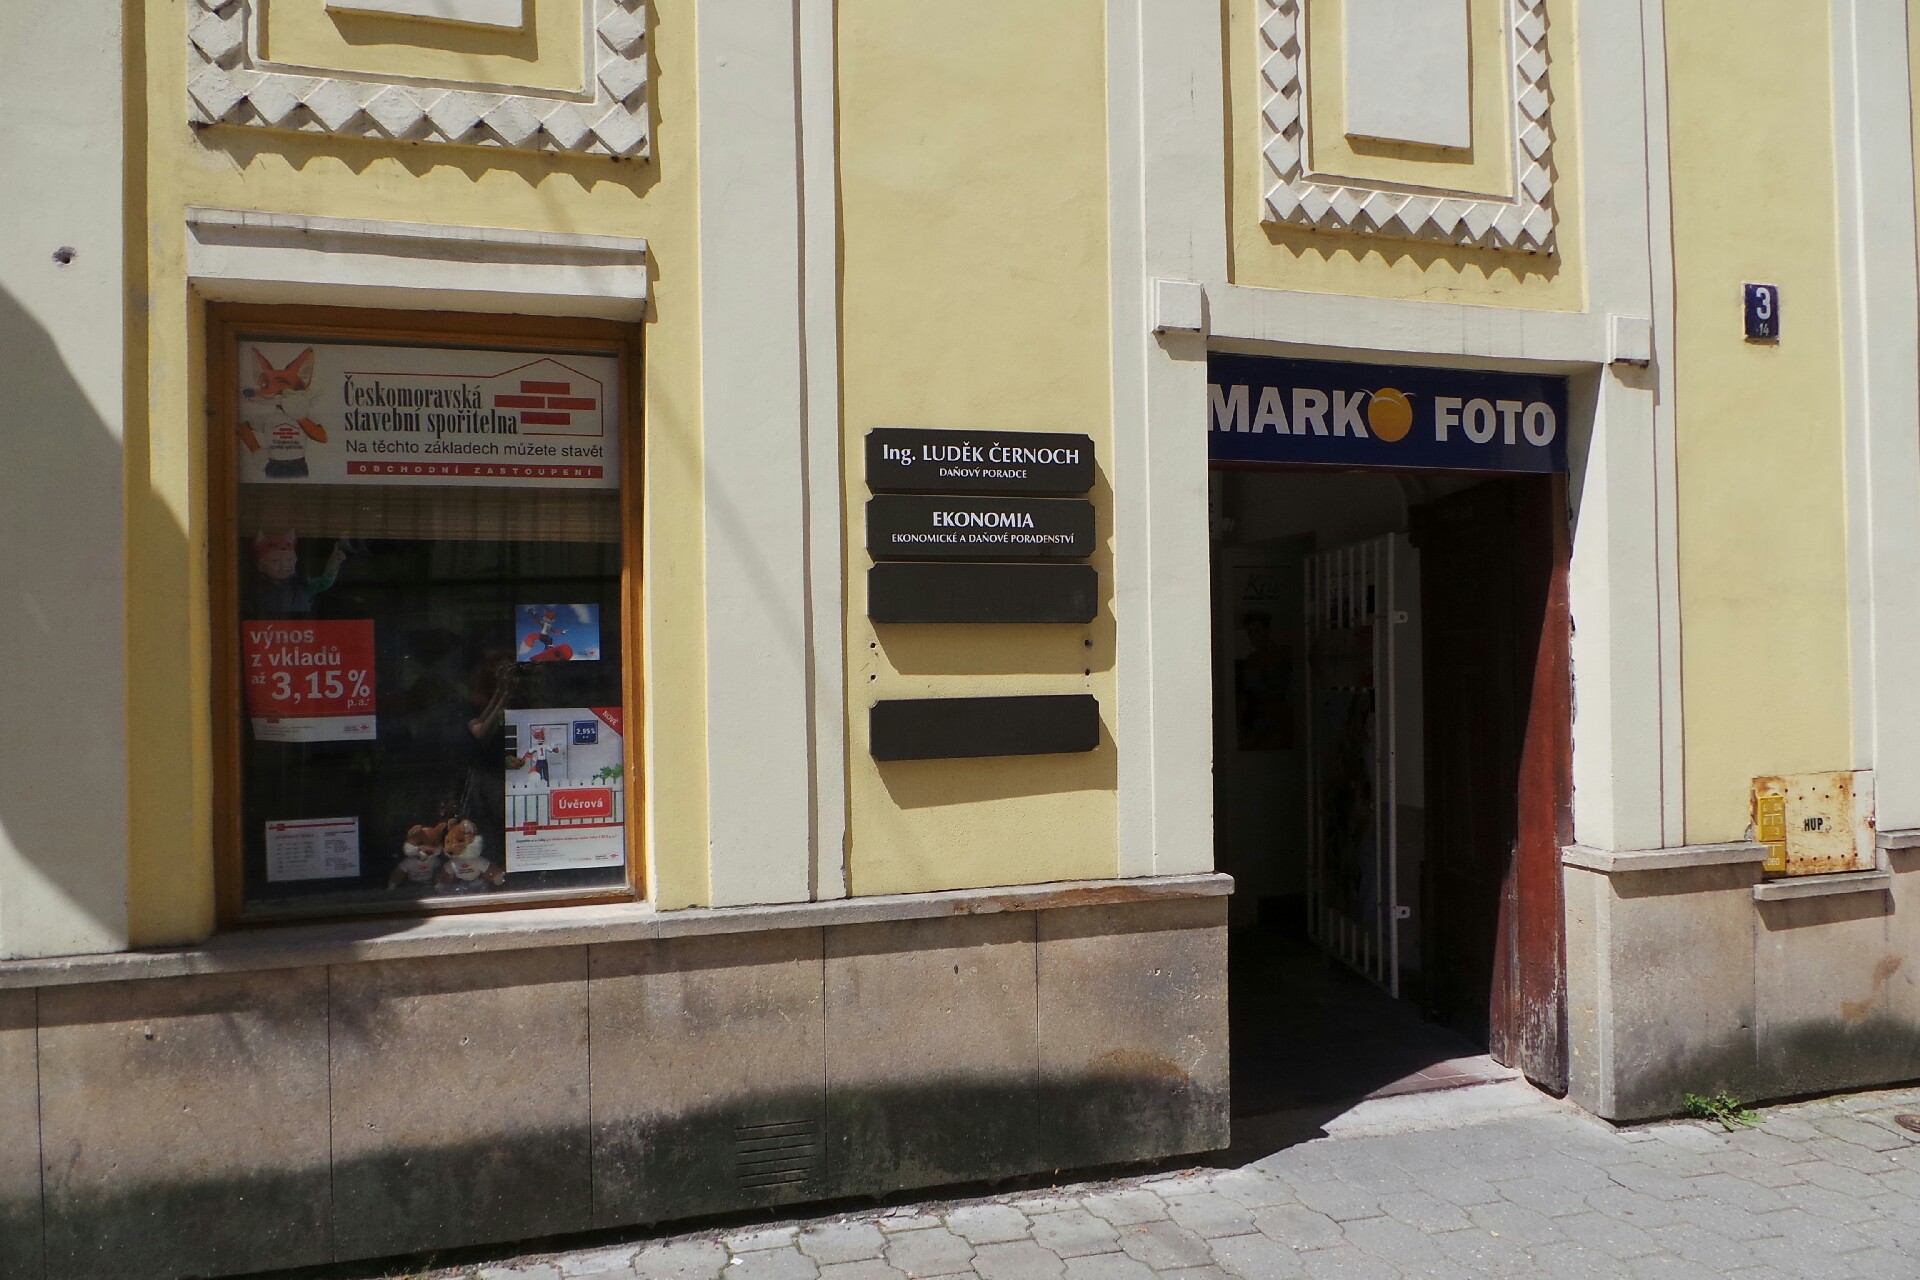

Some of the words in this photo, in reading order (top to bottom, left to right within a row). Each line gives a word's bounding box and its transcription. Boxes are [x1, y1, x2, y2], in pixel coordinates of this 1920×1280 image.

[1756, 287, 1770, 320] 3
[344, 375, 482, 410] Českomoravská
[344, 407, 421, 432] stavební
[427, 409, 518, 439] spořitelna
[1434, 396, 1556, 447] FOTO
[346, 440, 367, 453] Na
[373, 440, 419, 454] těchto
[425, 441, 498, 455] základech
[504, 443, 556, 457] můžete
[561, 444, 603, 458] stavět
[883, 444, 916, 465] Ing.
[923, 441, 984, 462] LUDĚK
[989, 442, 1079, 464] ČERNOCH
[359, 465, 459, 474] OBCHODNÍ
[474, 466, 592, 476] ZASTOUPENÍ
[939, 466, 981, 478] DAŇOVÝ
[983, 469, 1027, 479] PORADCE
[933, 511, 1034, 529] EKONOMIA
[891, 532, 957, 543] EKONOMICKÉ
[959, 533, 966, 543] A
[968, 531, 1008, 543] DAŇOVÉ
[1011, 533, 1075, 544] PORADENSTVÍ
[250, 624, 314, 649] výnos
[252, 654, 262, 667] z
[268, 646, 341, 667] vkladů
[252, 672, 266, 684] až
[558, 797, 603, 810] Úvěrová
[1804, 817, 1823, 832] HUP
